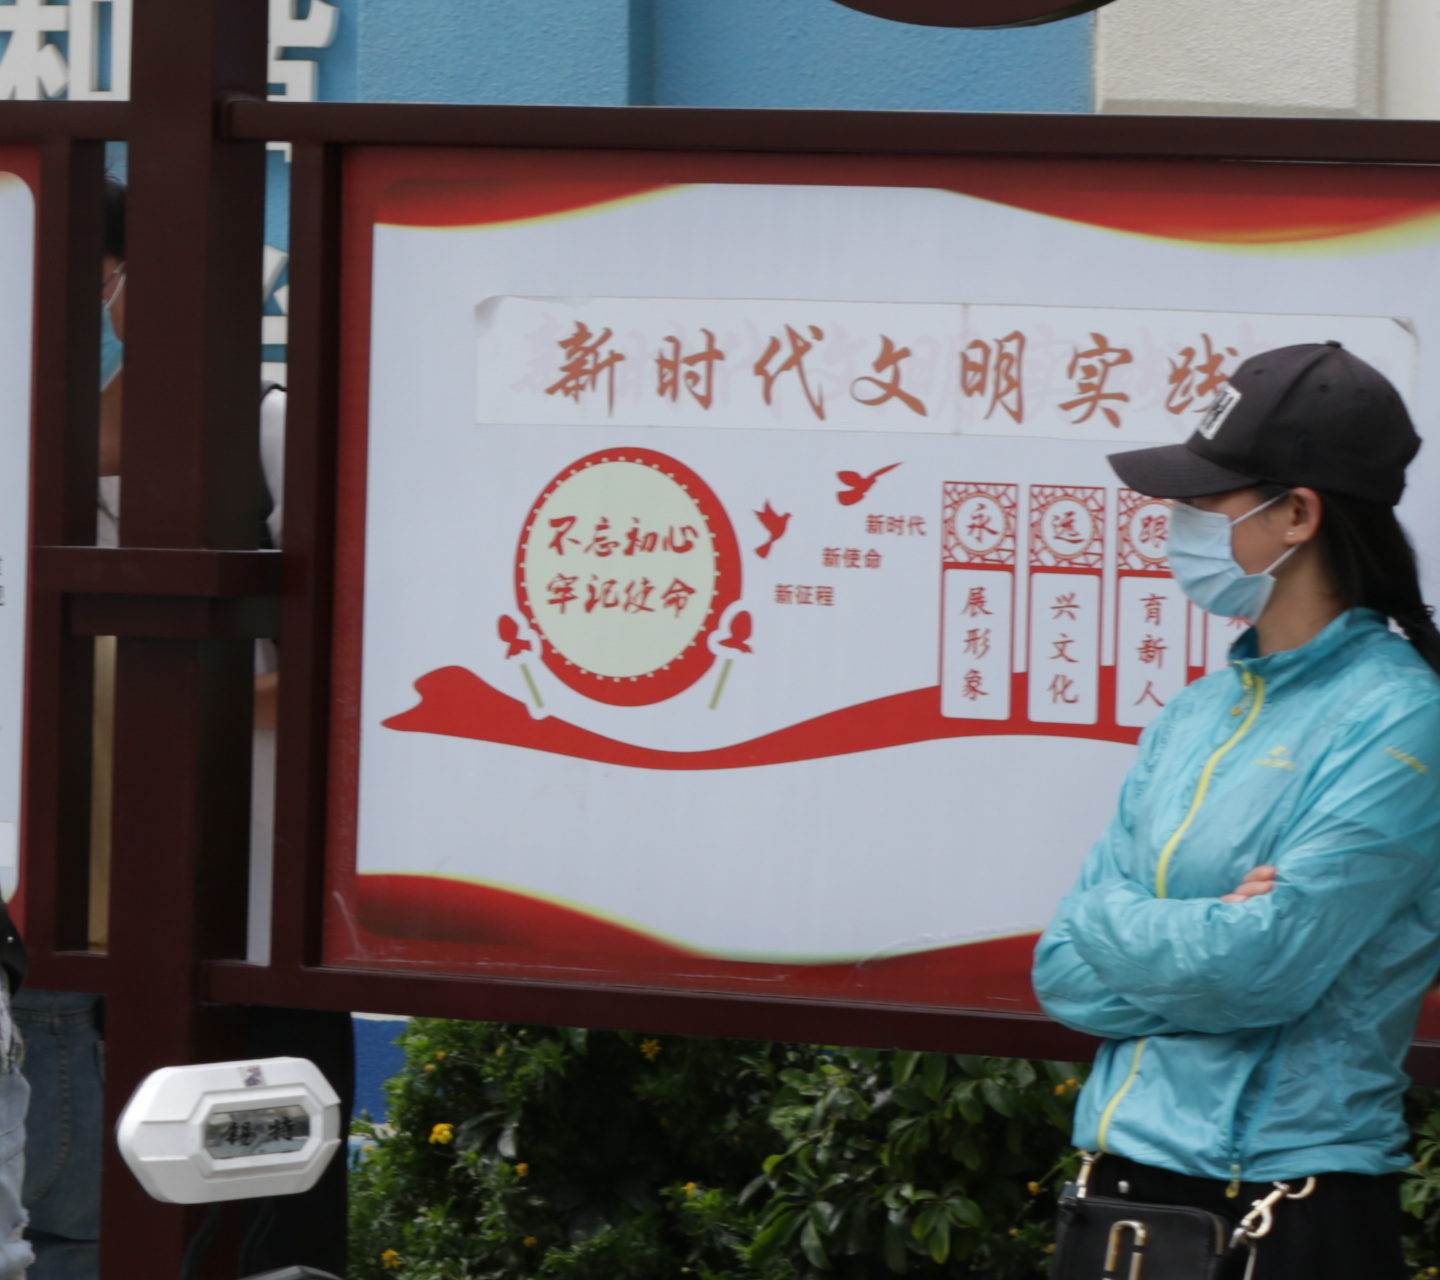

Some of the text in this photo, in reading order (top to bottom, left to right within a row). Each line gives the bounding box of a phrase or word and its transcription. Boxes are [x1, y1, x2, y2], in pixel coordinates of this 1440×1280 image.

[545, 320, 1239, 428] 新时代文明实践
[547, 515, 700, 558] 不忘初心
[865, 513, 927, 537] 新时代
[966, 503, 999, 543] 永
[1051, 511, 1085, 544] 远
[822, 546, 883, 570] 新使命
[546, 573, 697, 619] 牢记使命
[774, 583, 836, 607] 新征程
[960, 586, 994, 702] 展形象
[1047, 592, 1081, 705] 兴文化
[1133, 593, 1168, 709] 育新人
